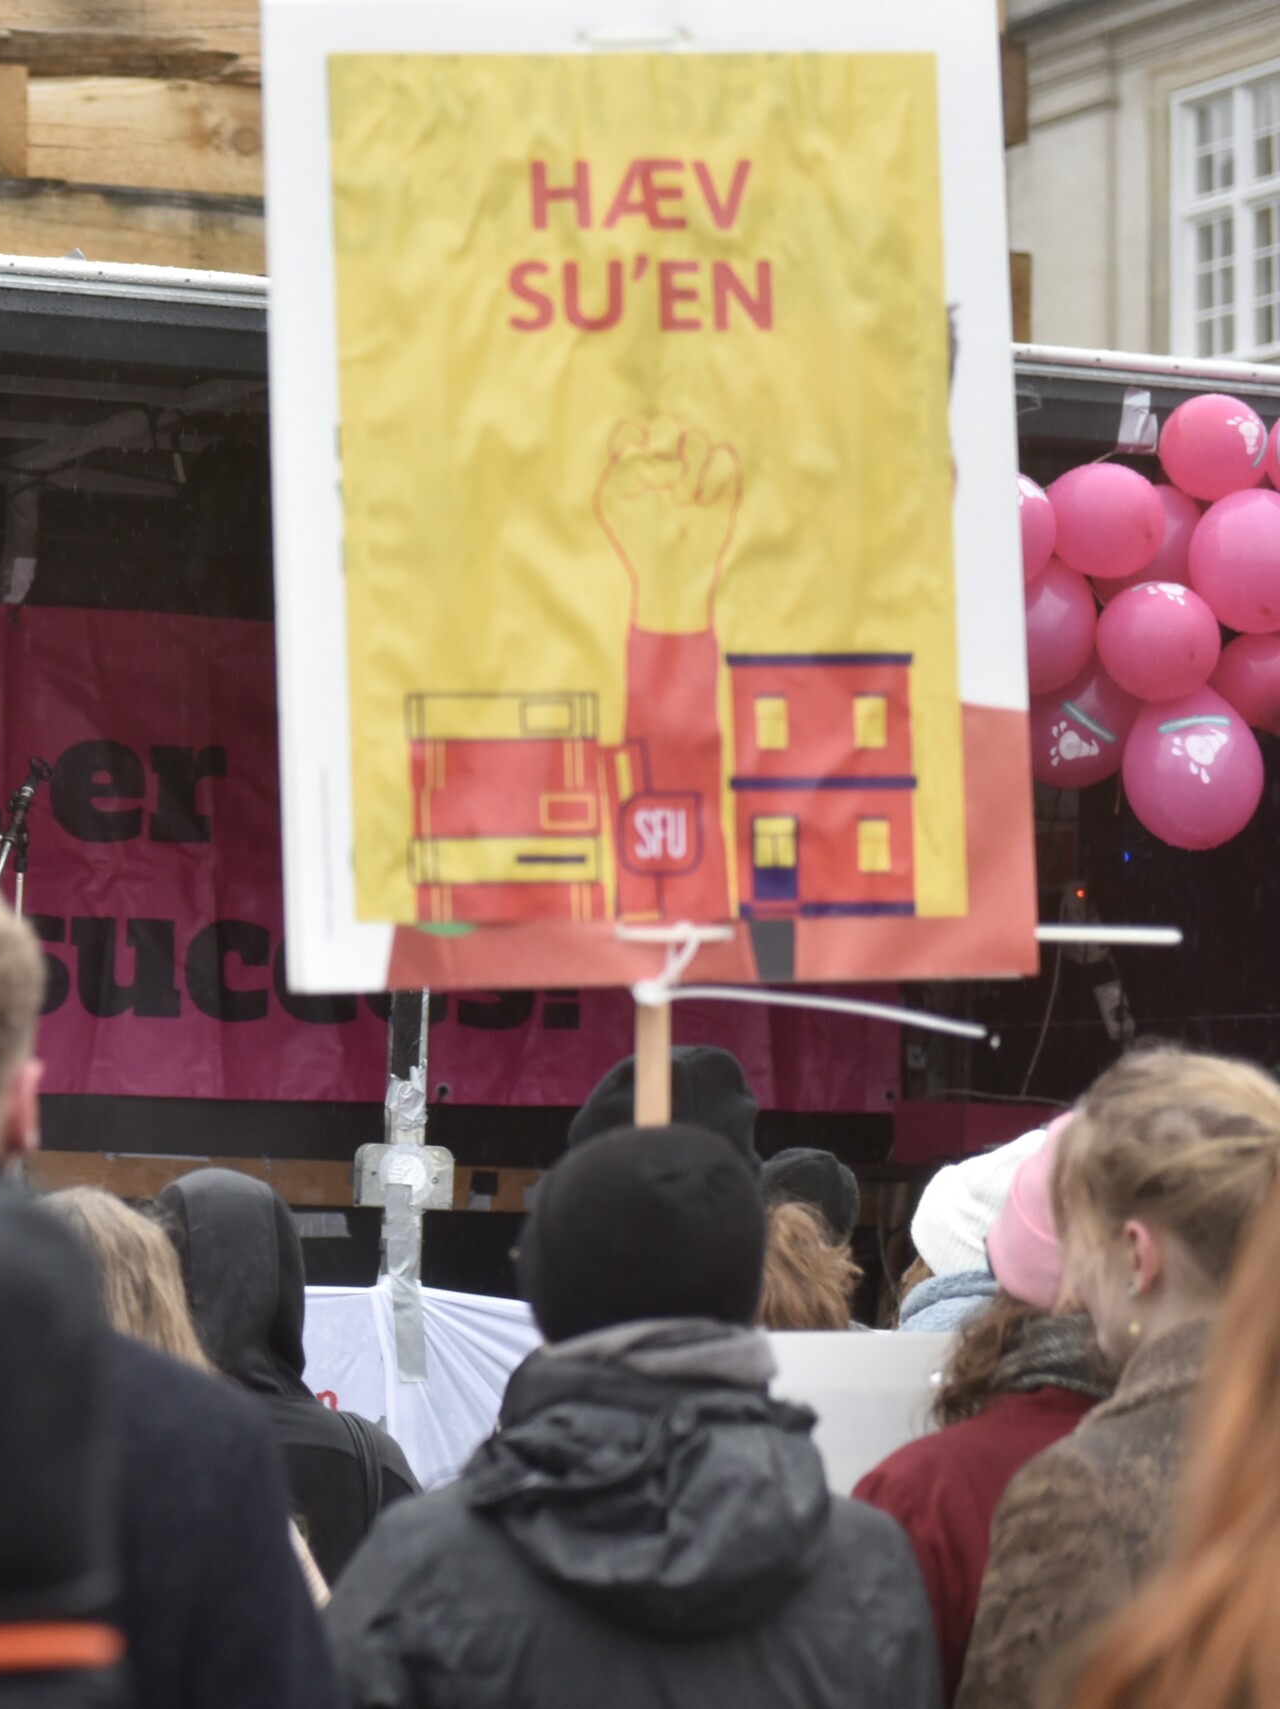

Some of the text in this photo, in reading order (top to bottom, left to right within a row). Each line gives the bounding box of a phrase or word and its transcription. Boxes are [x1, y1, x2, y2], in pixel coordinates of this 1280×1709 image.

[530, 159, 751, 231] HÆV
[507, 253, 773, 331] SU'EN
[51, 737, 226, 843] er
[634, 808, 687, 859] SFU
